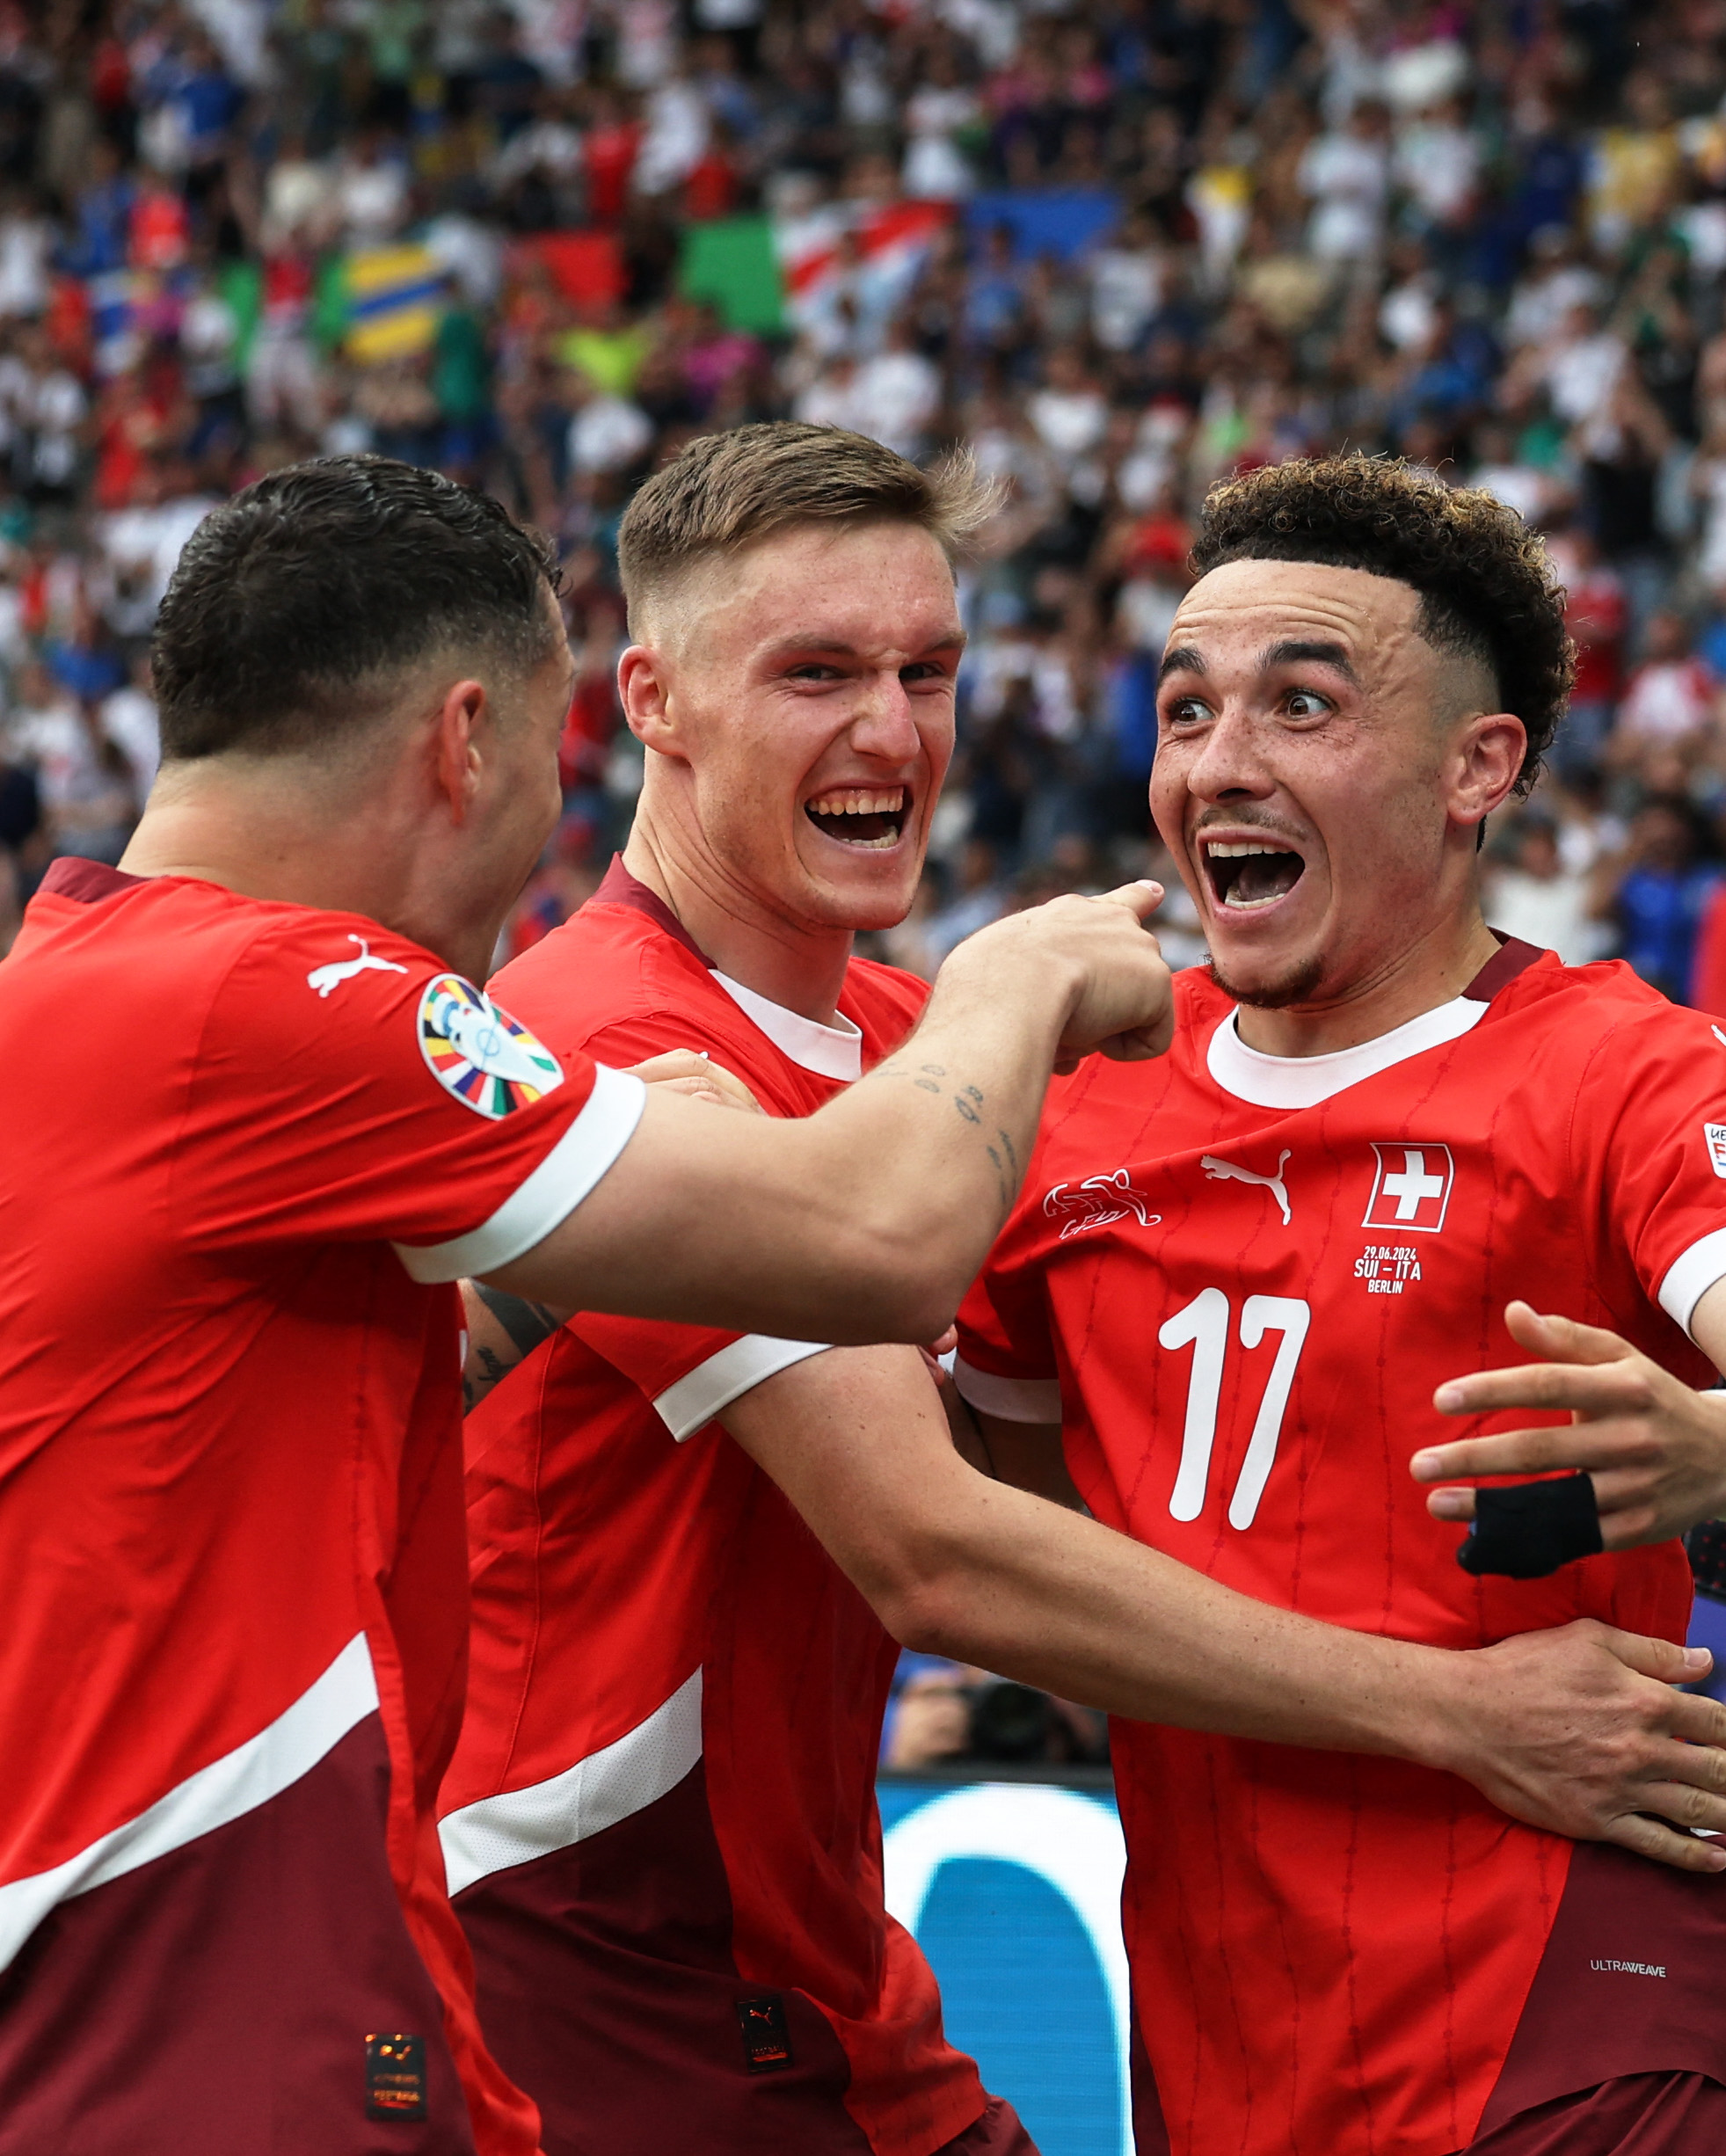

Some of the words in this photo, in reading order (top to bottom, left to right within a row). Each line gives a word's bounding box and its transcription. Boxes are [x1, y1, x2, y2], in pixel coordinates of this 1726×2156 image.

[1363, 1245, 1416, 1261] 29.06.2024
[1354, 1258, 1380, 1278] SUI
[1395, 1260, 1422, 1281] ITA
[1367, 1278, 1403, 1294] BERLIN
[1158, 1287, 1311, 1531] 17
[1590, 1959, 1666, 1978] ULTRAWEAVE
